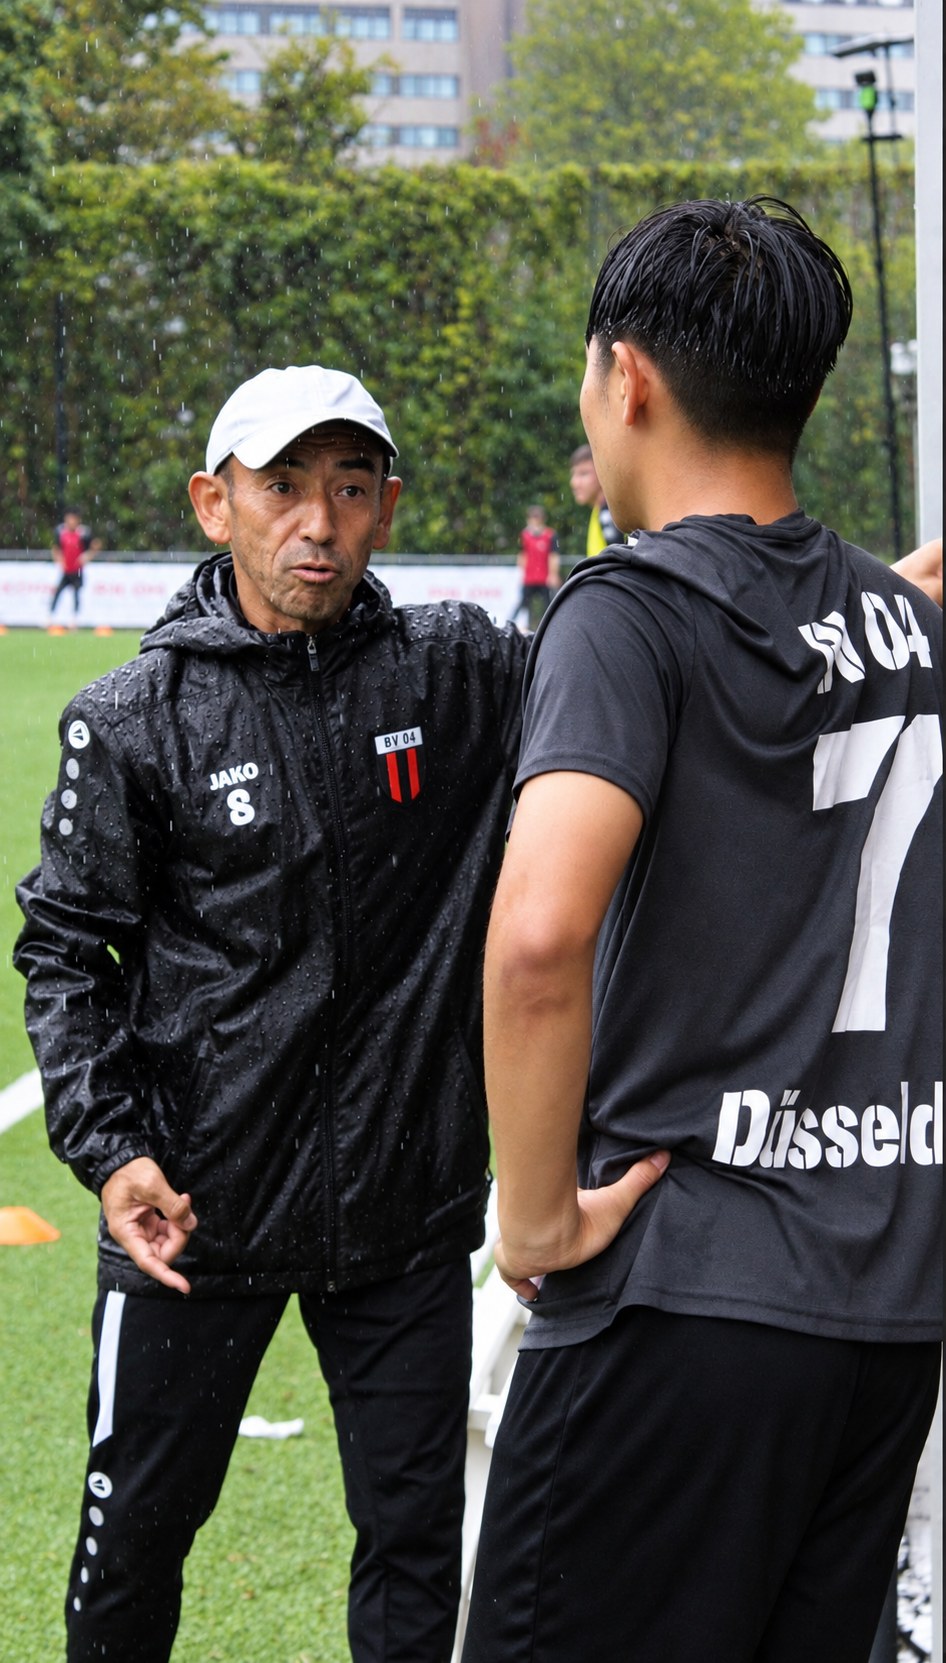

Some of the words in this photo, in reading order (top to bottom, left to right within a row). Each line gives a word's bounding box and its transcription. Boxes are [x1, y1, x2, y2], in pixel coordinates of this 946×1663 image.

[861, 591, 933, 670] 04
[384, 734, 398, 748] BV
[402, 731, 416, 745] 04
[209, 762, 259, 791] JAKO
[813, 714, 943, 1033] 7
